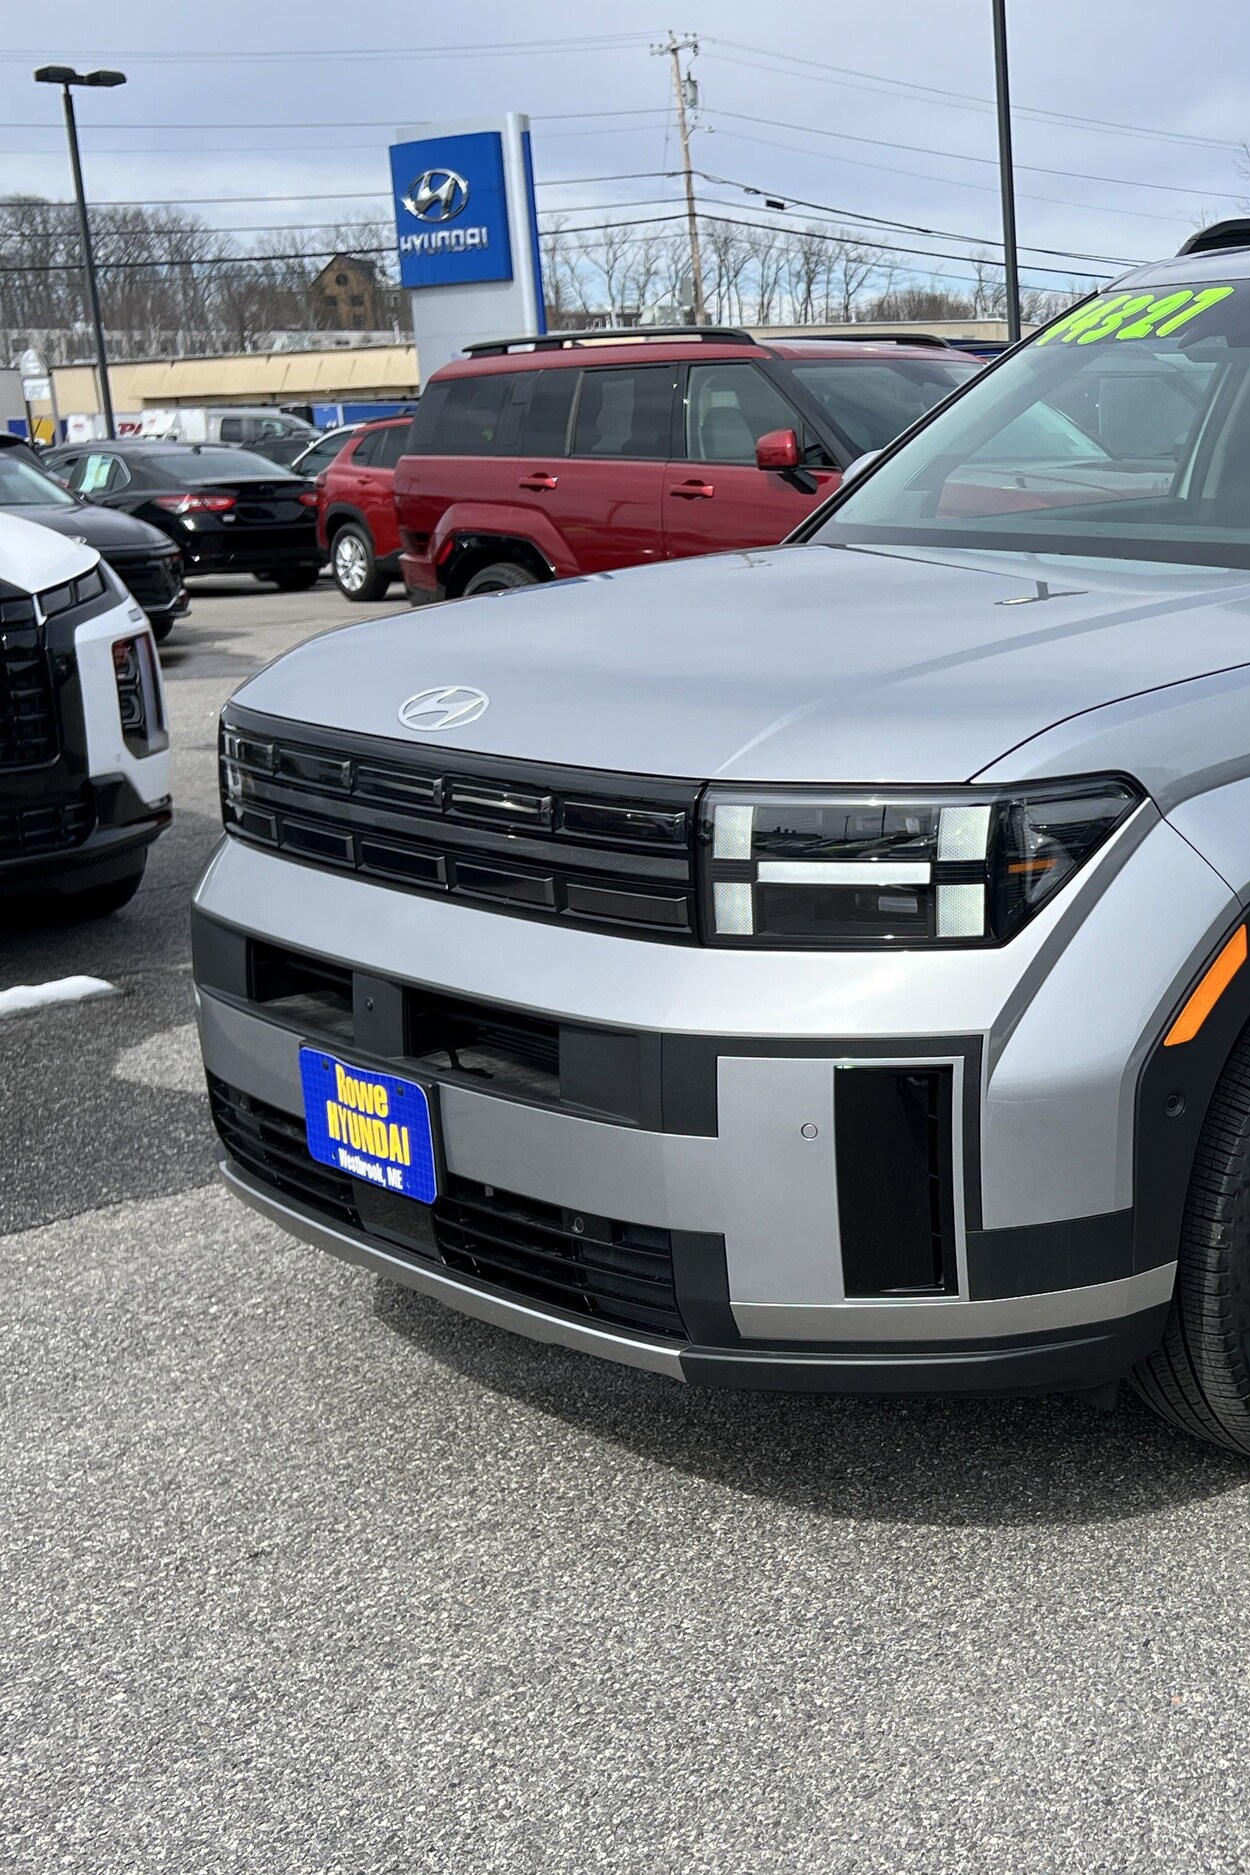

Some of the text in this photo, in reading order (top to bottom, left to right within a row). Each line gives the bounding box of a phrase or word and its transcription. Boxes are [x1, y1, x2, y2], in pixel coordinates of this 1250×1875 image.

[400, 226, 489, 254] HYUNDAI
[335, 1063, 389, 1118] Rowe
[326, 1100, 411, 1166] HYUNDAI
[387, 1166, 403, 1190] ME
